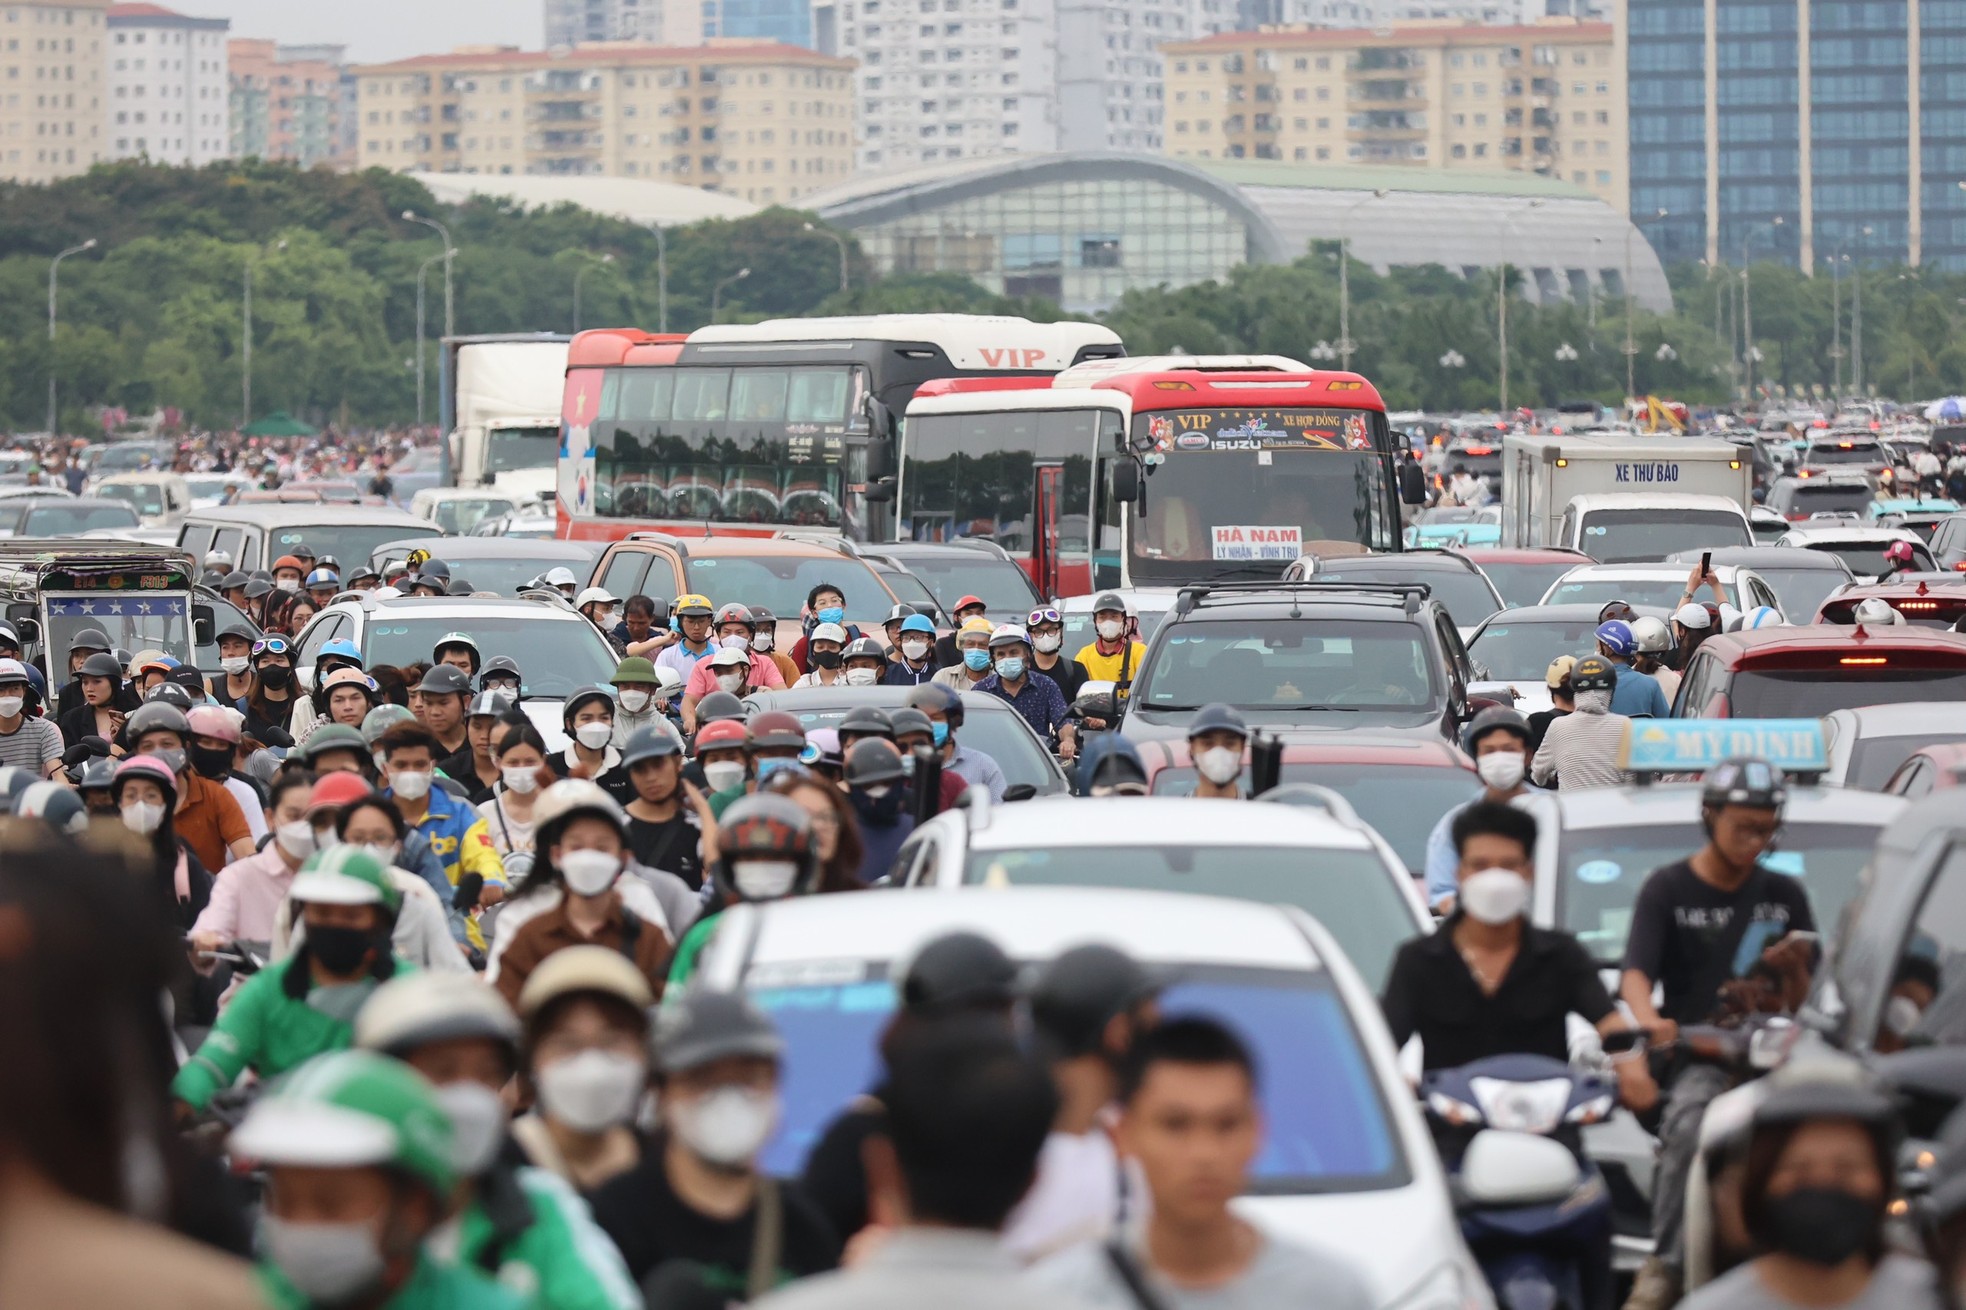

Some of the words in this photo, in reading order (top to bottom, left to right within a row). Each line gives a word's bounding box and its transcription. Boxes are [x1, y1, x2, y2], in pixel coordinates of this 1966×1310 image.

[979, 349, 1046, 368] VIP
[1177, 414, 1212, 429] VIP
[1283, 415, 1295, 426] XE
[1211, 440, 1262, 450] ISUZU
[1615, 463, 1630, 482] XE
[1250, 529, 1297, 542] NAM
[140, 575, 168, 589] F313
